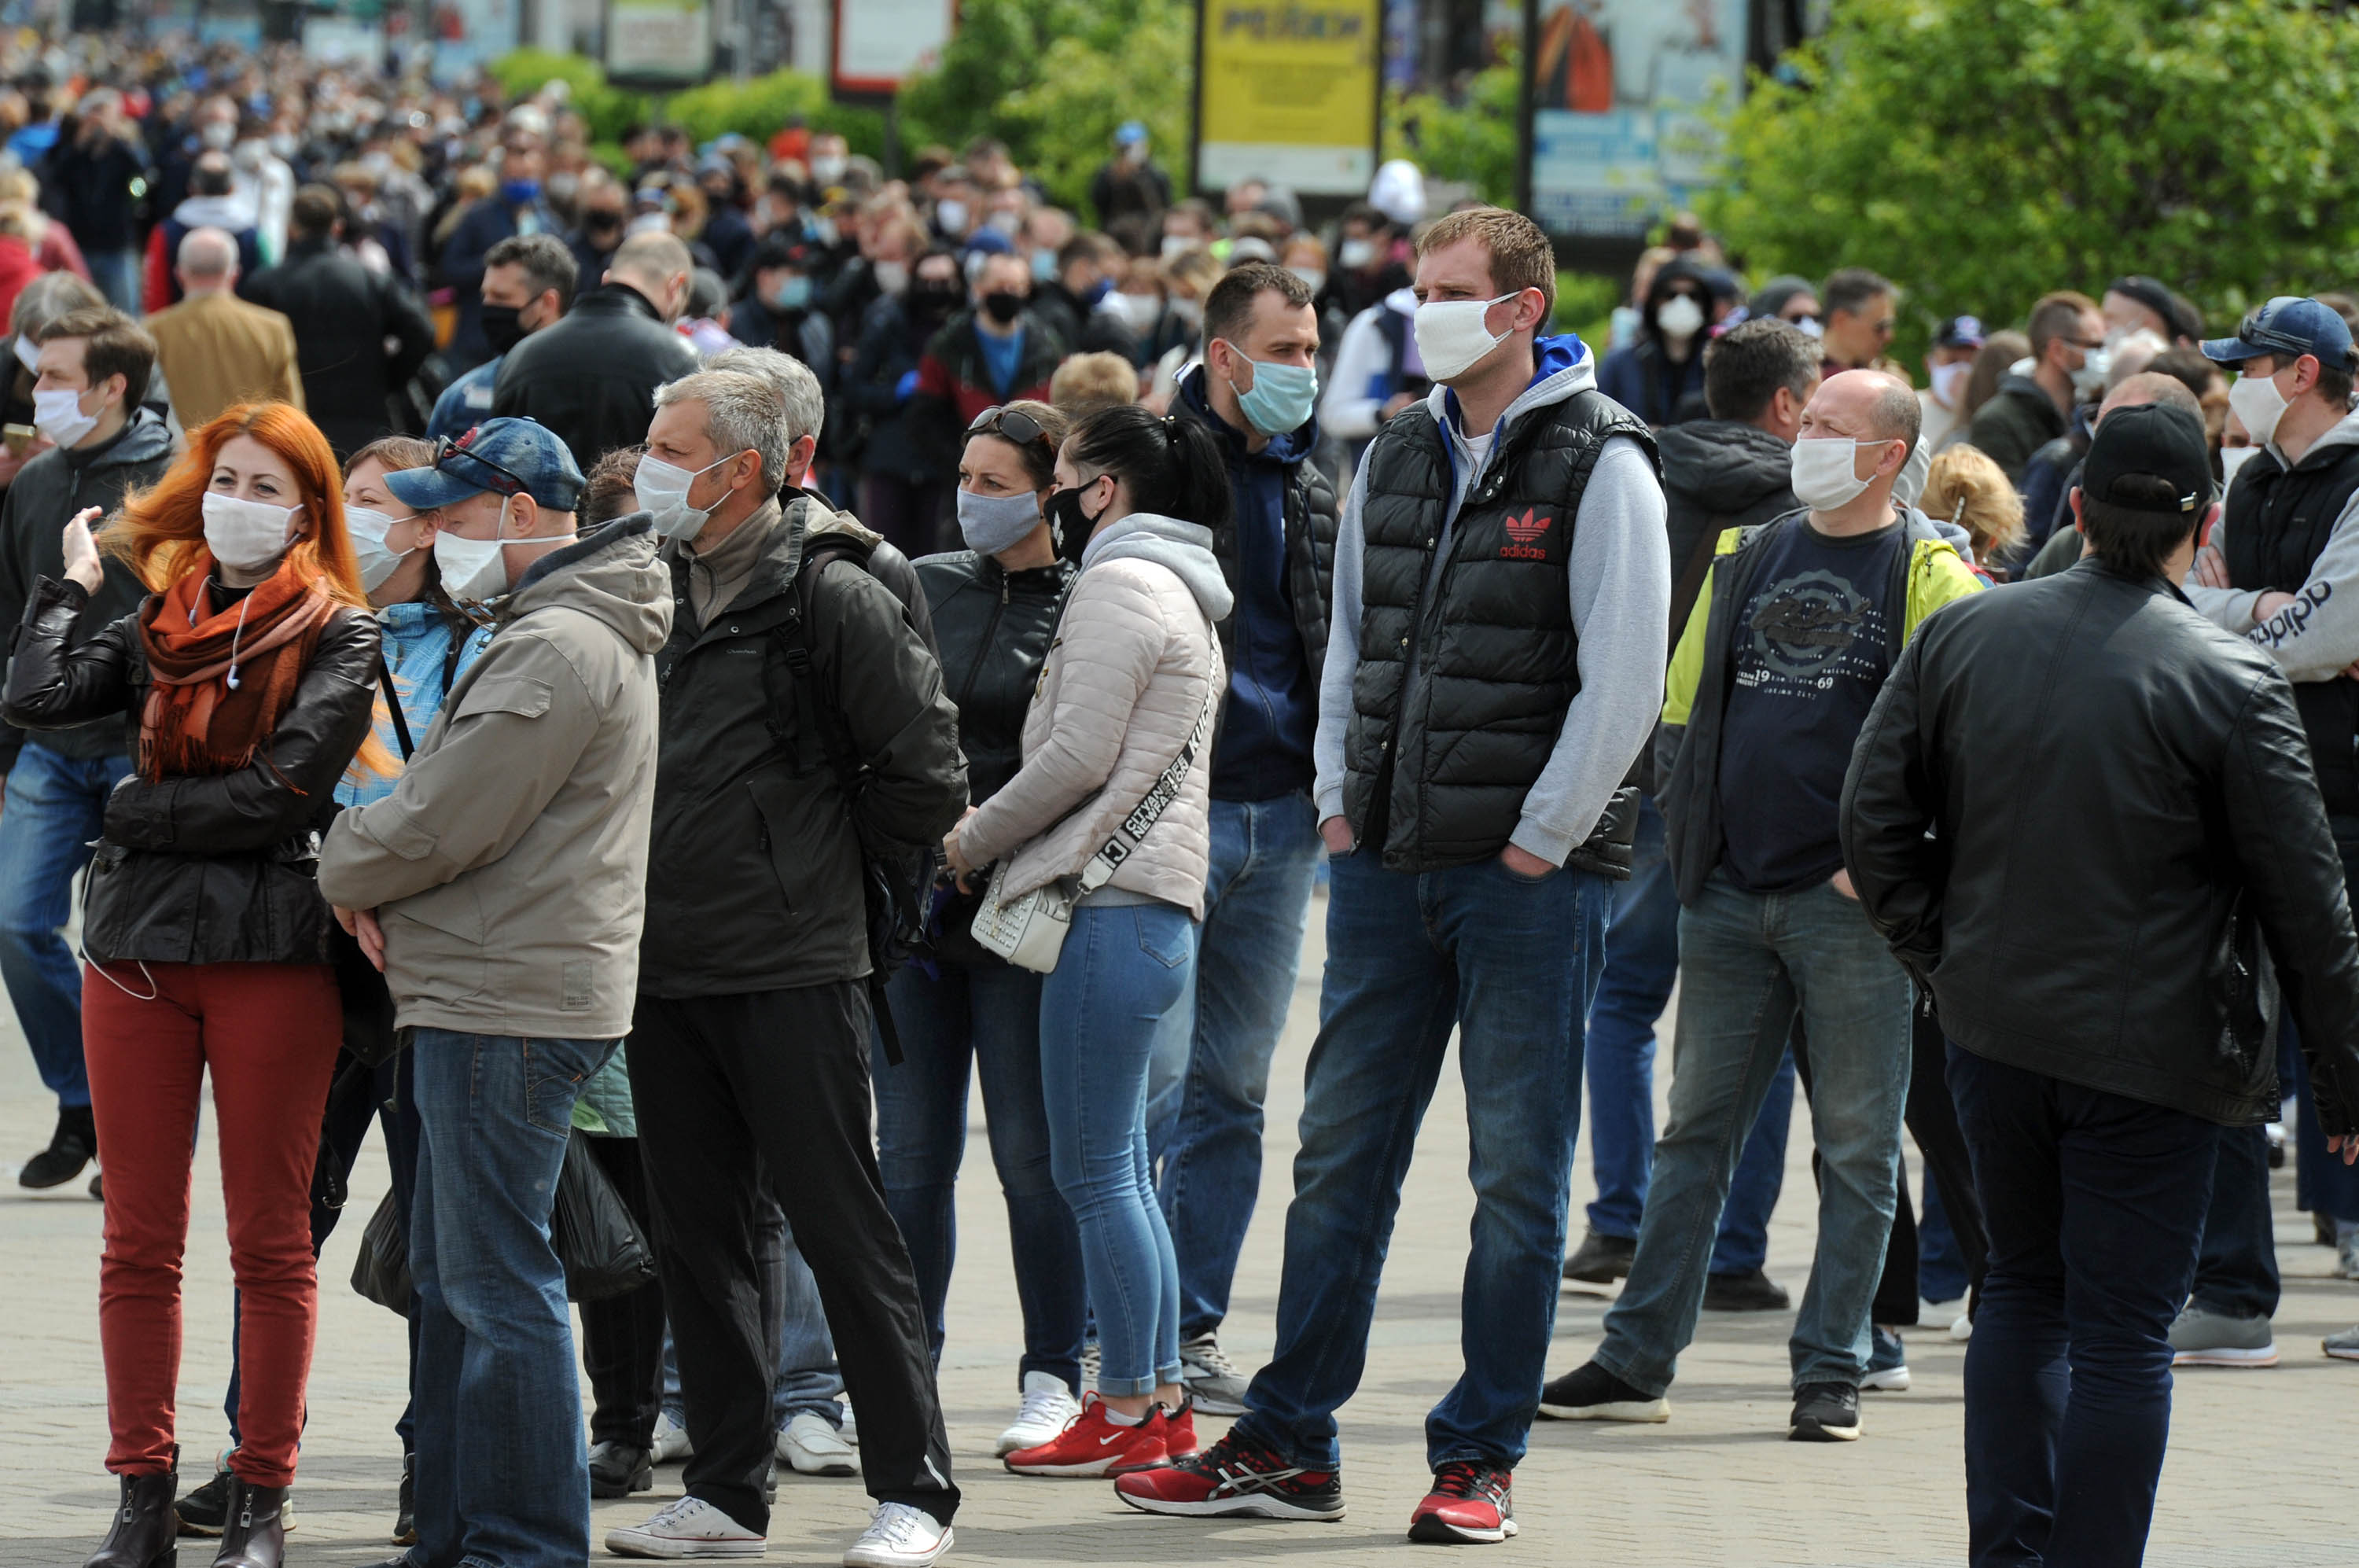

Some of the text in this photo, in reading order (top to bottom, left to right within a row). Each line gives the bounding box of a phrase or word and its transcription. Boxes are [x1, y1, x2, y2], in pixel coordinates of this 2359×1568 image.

[1500, 544, 1547, 559] adidas
[1756, 669, 1771, 683] 19
[1817, 676, 1834, 690] 69
